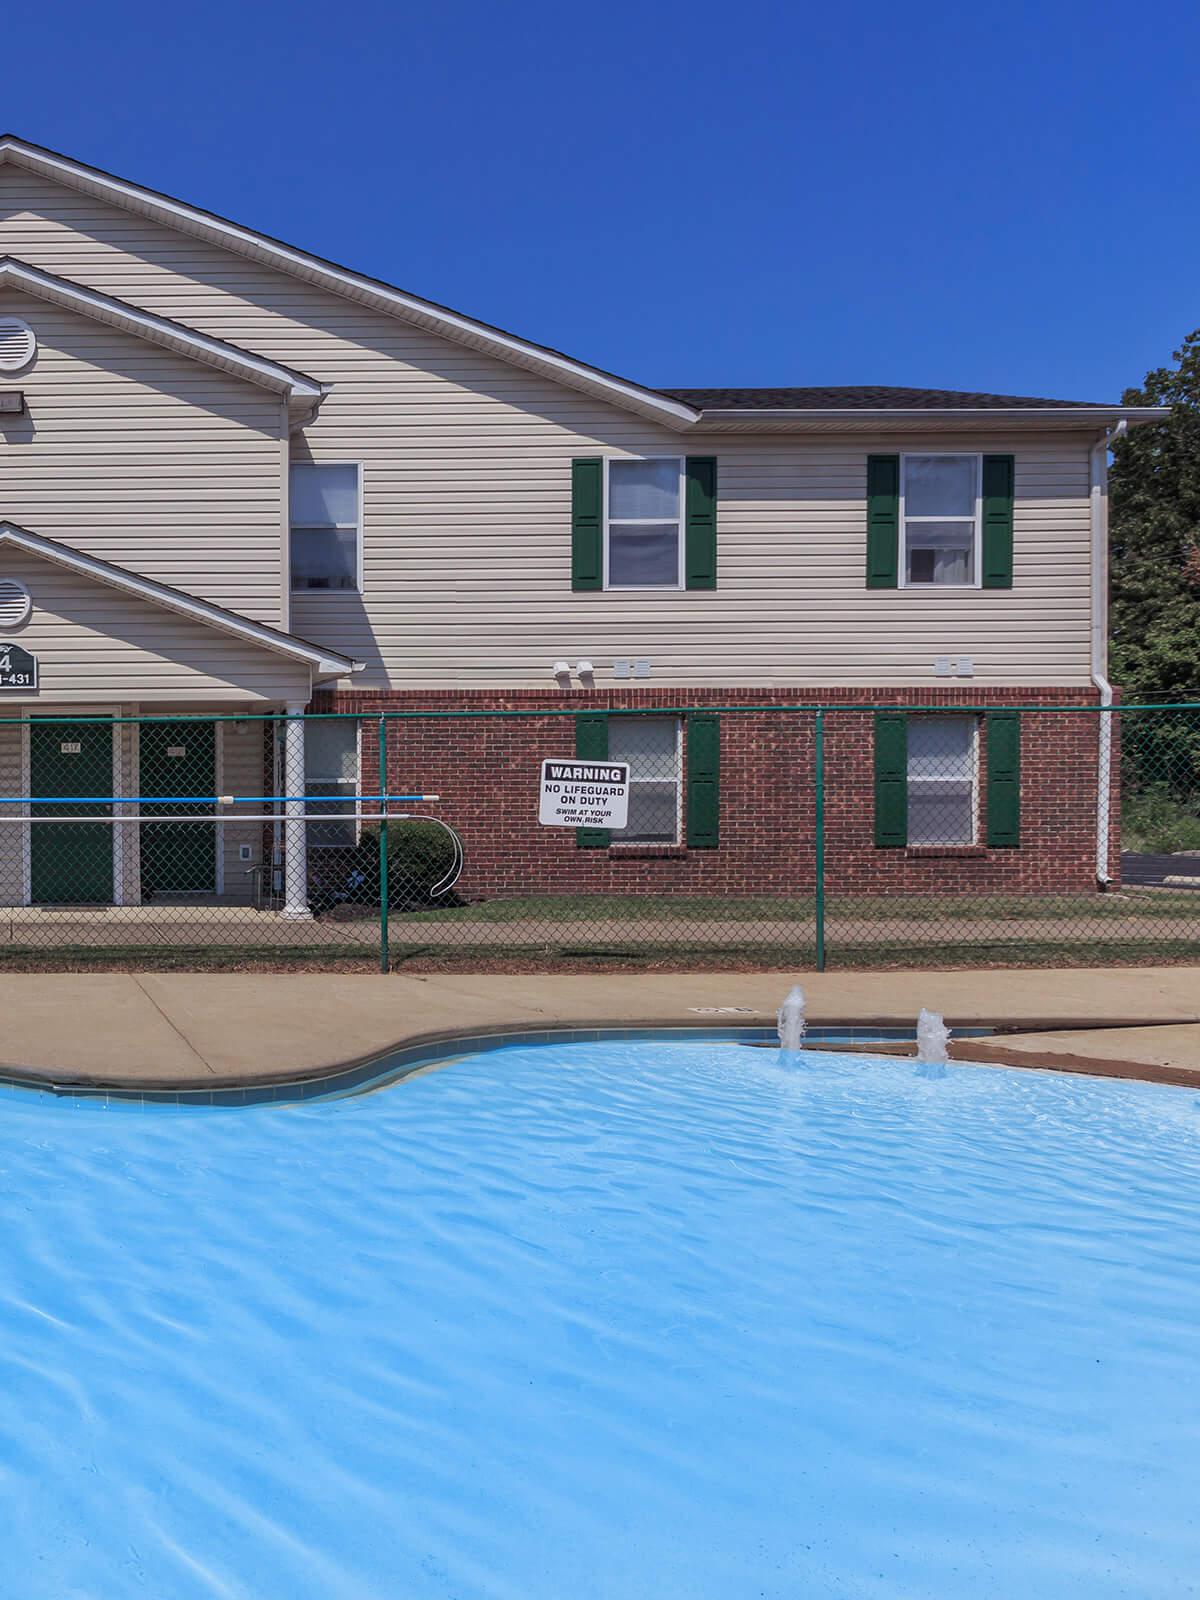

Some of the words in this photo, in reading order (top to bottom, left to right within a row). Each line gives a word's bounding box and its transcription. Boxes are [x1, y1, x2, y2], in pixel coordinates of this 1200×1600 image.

[551, 766, 621, 780] WARNING
[545, 785, 560, 793] NO
[564, 785, 624, 796] LIFEGUARD
[560, 796, 576, 804] ON
[580, 797, 608, 806] DUTY
